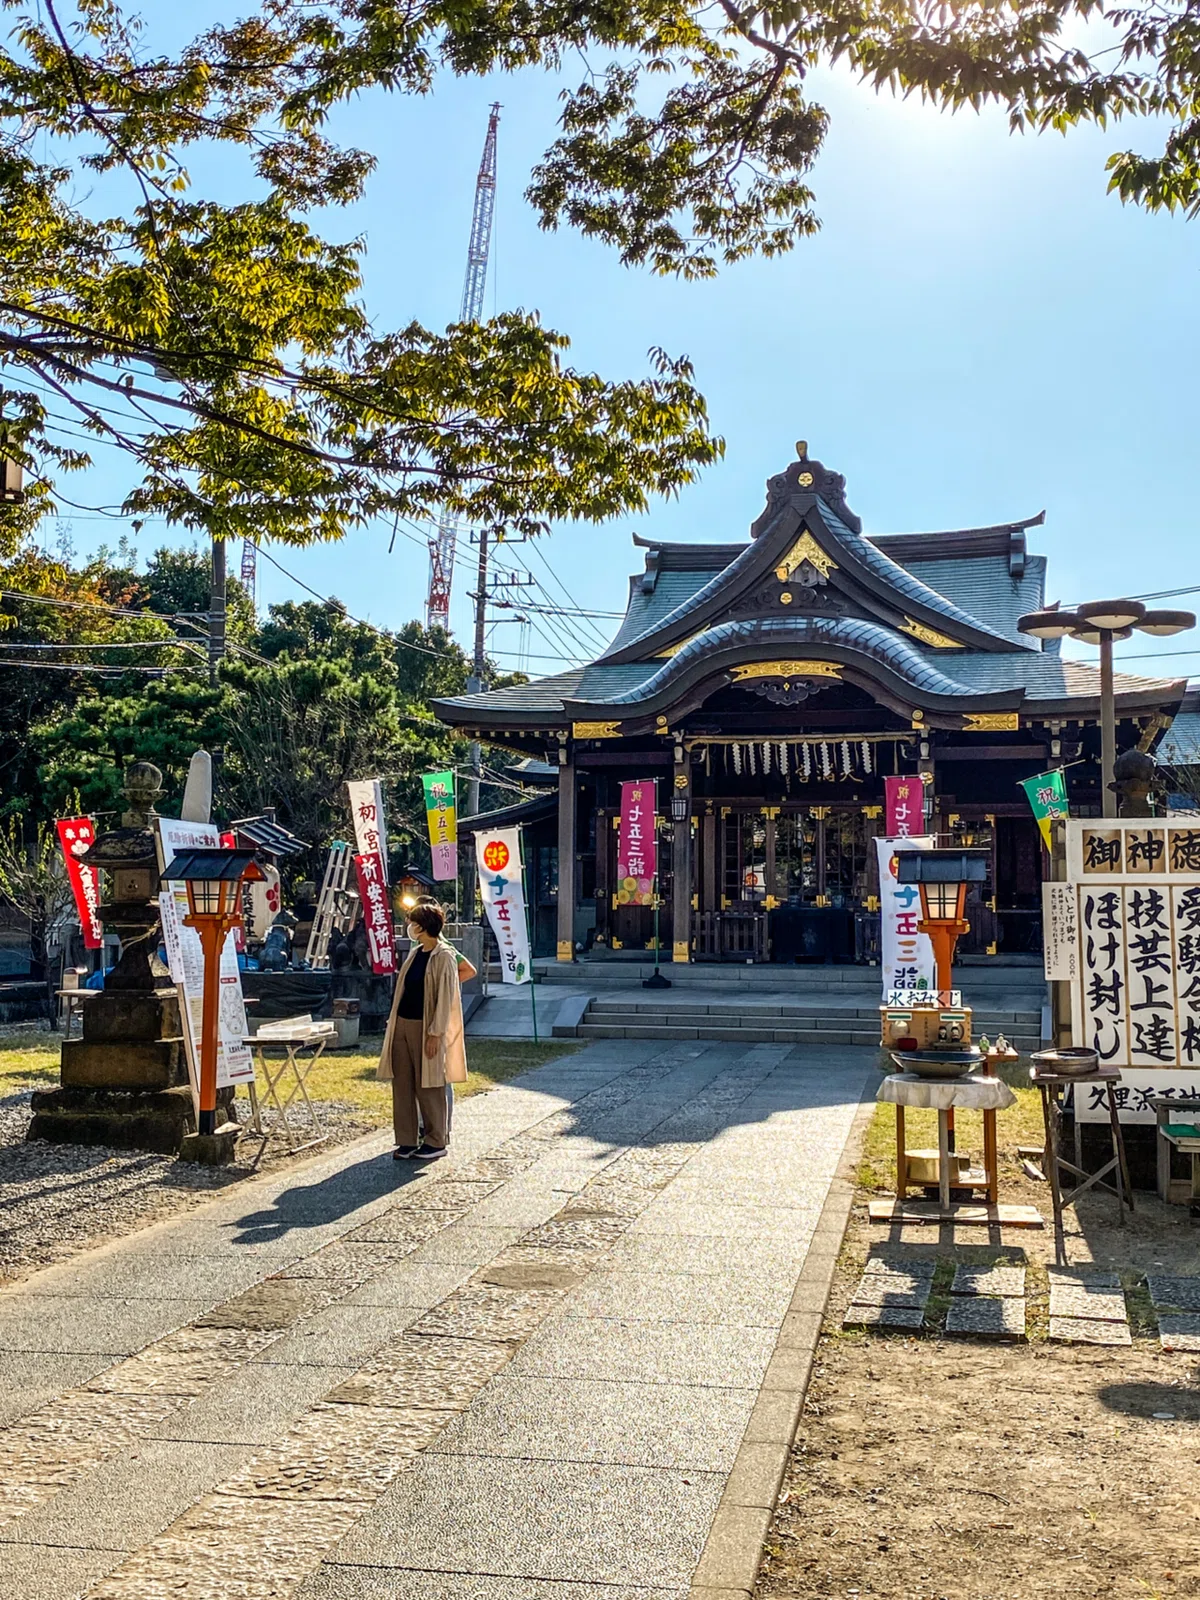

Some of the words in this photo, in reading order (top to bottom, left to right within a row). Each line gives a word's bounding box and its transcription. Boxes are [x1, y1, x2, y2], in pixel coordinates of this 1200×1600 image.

[358, 802, 380, 851] 初宮
[431, 782, 450, 872] 祝七五三詣り
[361, 858, 393, 968] 祈安産祈願
[1084, 891, 1125, 1060] ぼけ封じ
[1127, 888, 1177, 1062] 技芸上達
